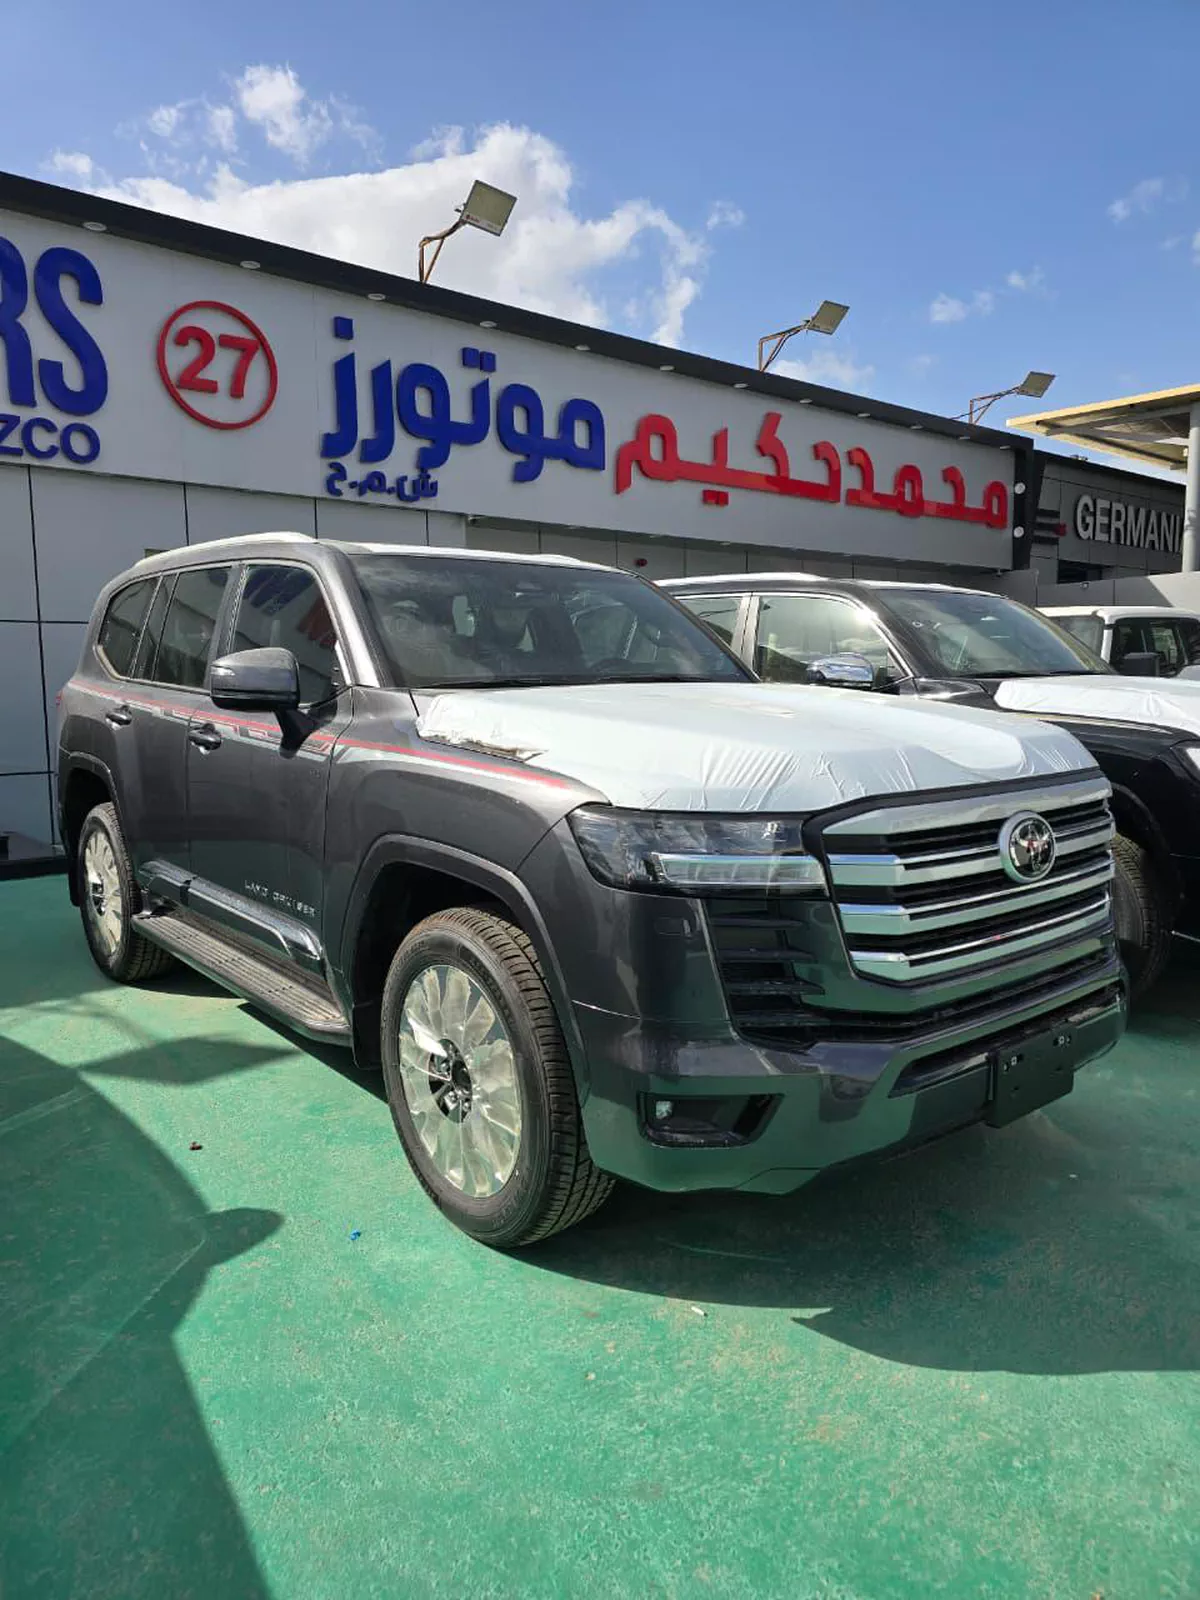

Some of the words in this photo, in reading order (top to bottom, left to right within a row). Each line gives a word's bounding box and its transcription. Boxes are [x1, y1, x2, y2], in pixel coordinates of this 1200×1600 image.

[173, 326, 260, 398] 27
[321, 316, 605, 482] موتورز
[615, 412, 841, 506] حكيم
[845, 446, 1008, 528] محمد
